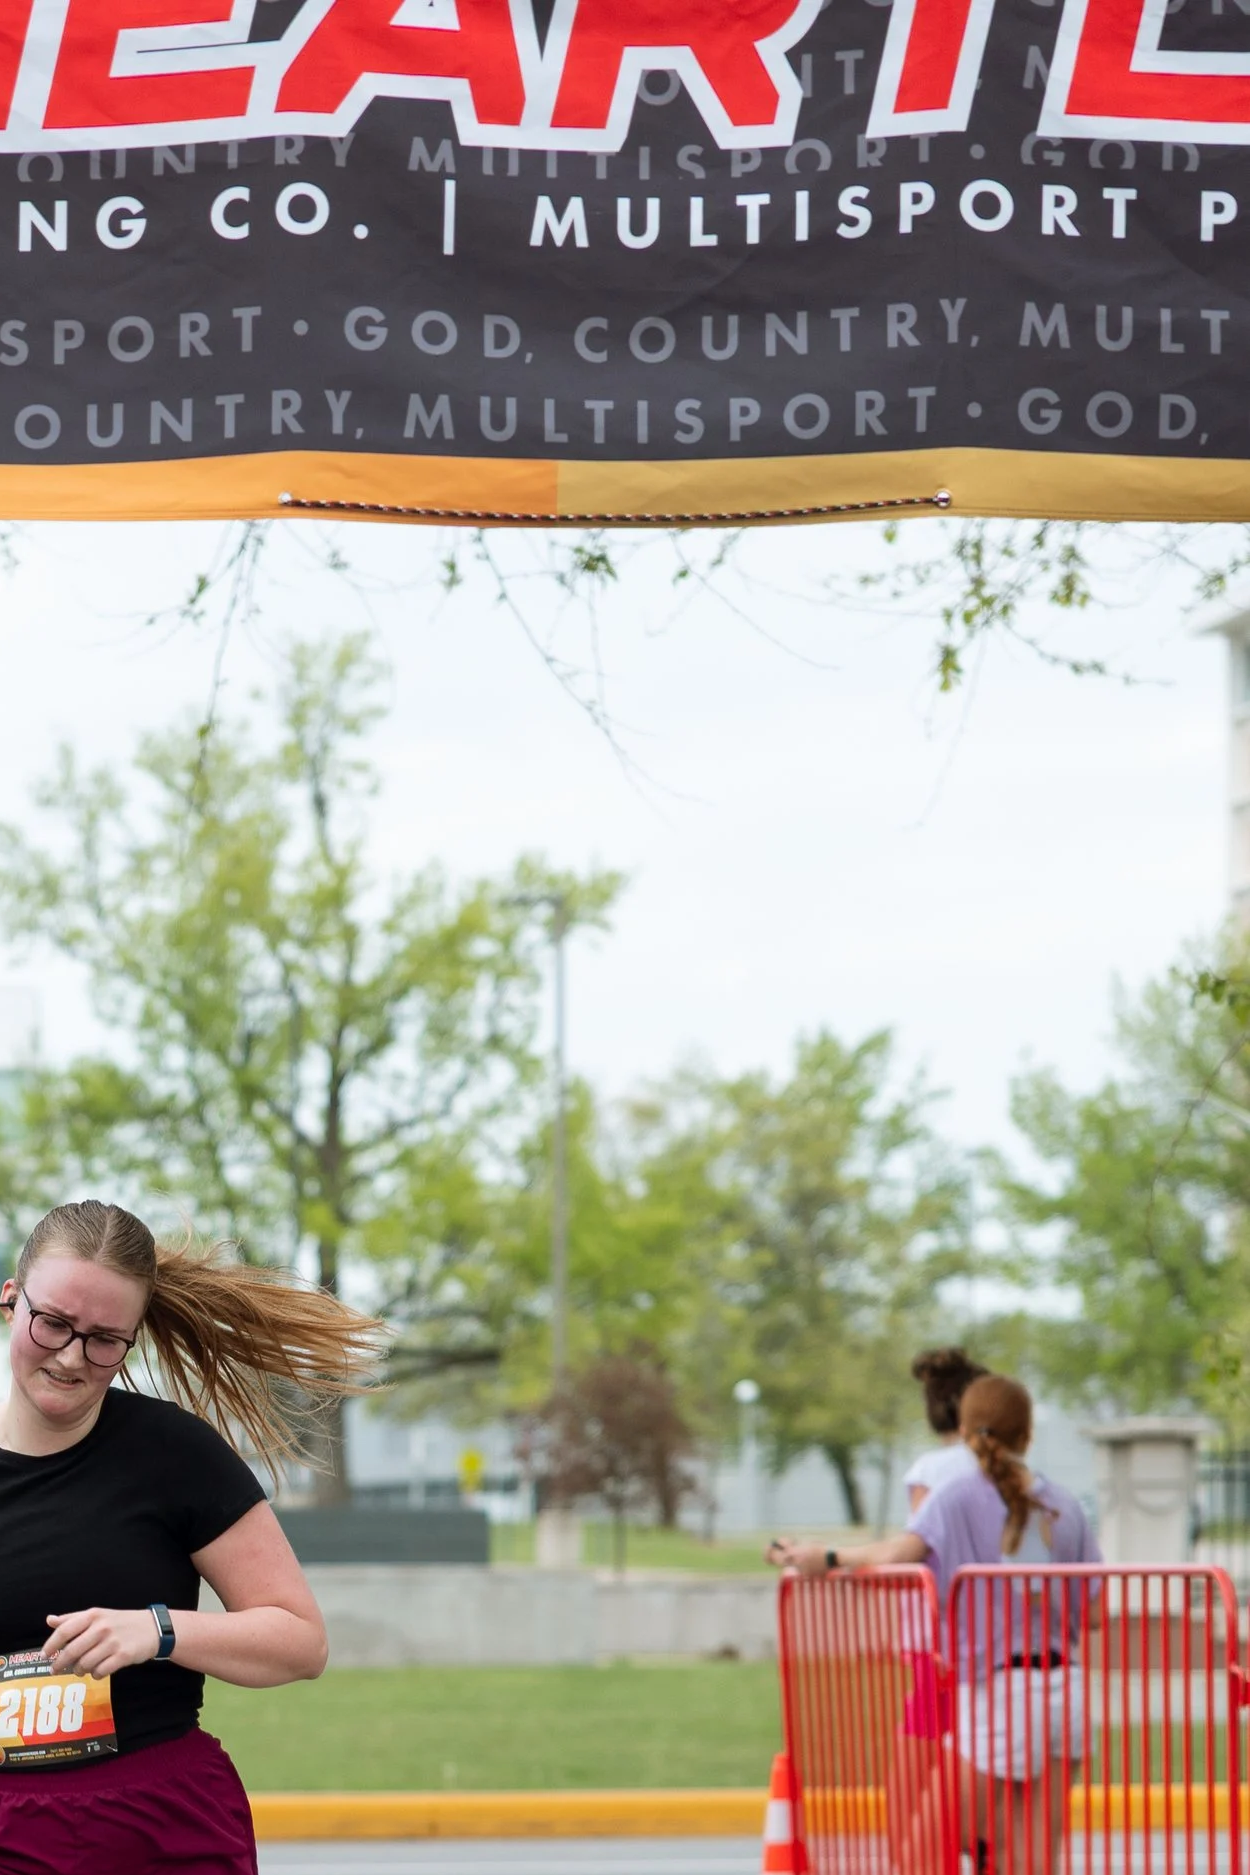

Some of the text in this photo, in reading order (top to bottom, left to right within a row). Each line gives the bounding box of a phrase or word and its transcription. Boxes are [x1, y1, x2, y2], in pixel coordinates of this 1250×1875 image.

[210, 182, 369, 240] CO.
[529, 178, 1137, 250] MULTISPORT
[344, 306, 533, 364] GOD,
[573, 298, 979, 364] COUNTRY,
[1019, 301, 1231, 355] MULT
[403, 386, 936, 444] MULTISPORT
[1017, 387, 1208, 445] GOD,
